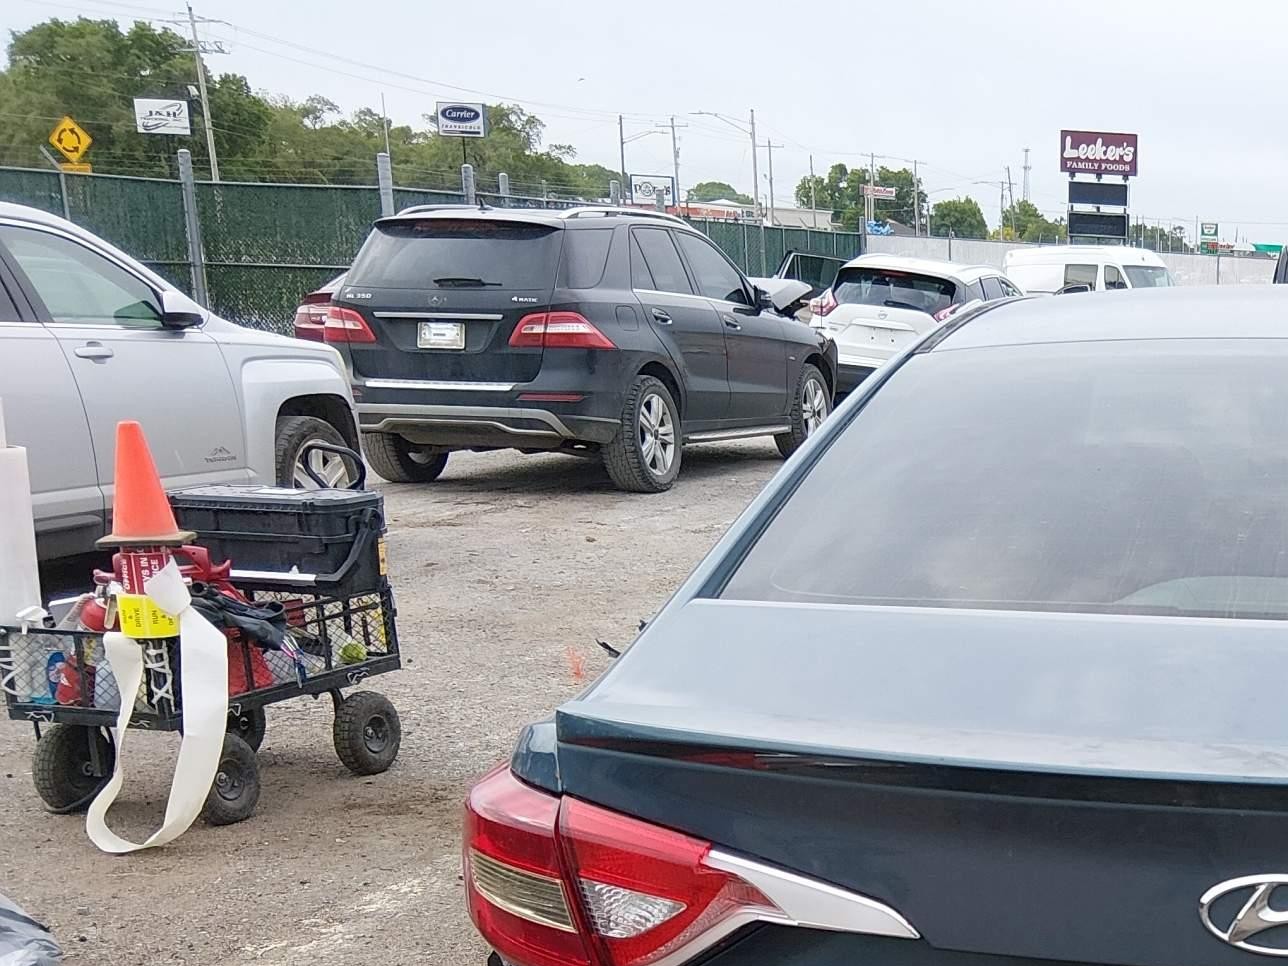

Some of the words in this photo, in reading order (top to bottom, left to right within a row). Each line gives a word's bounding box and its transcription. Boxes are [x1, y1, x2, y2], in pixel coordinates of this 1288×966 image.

[445, 108, 476, 119] Carrier
[1063, 135, 1134, 162] Leeker's
[1066, 160, 1099, 170] FAMILY
[1101, 163, 1130, 172] FOODS
